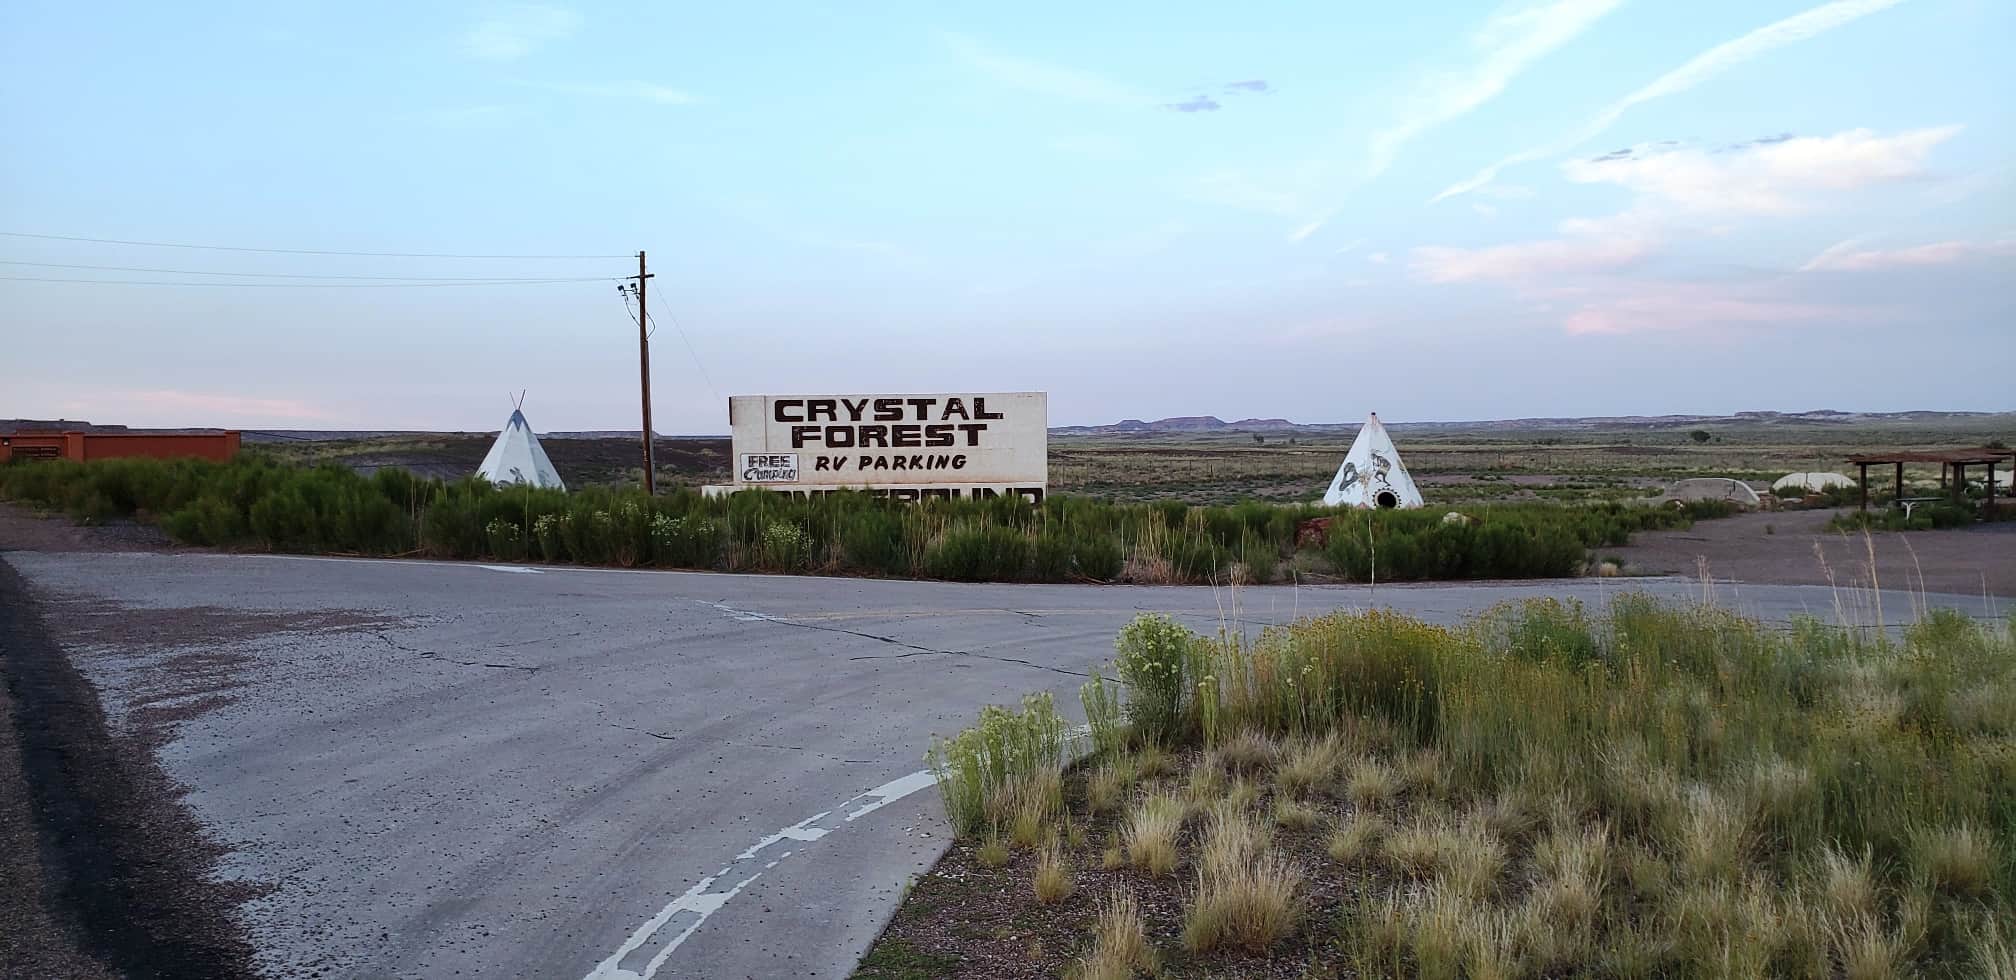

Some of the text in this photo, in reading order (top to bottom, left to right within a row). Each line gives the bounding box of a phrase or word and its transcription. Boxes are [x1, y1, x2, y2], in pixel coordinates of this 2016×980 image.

[774, 397, 1004, 422] CRYSTAL
[791, 423, 988, 448] FOREST
[748, 455, 791, 467] FREE
[815, 454, 967, 472] RV PARKING
